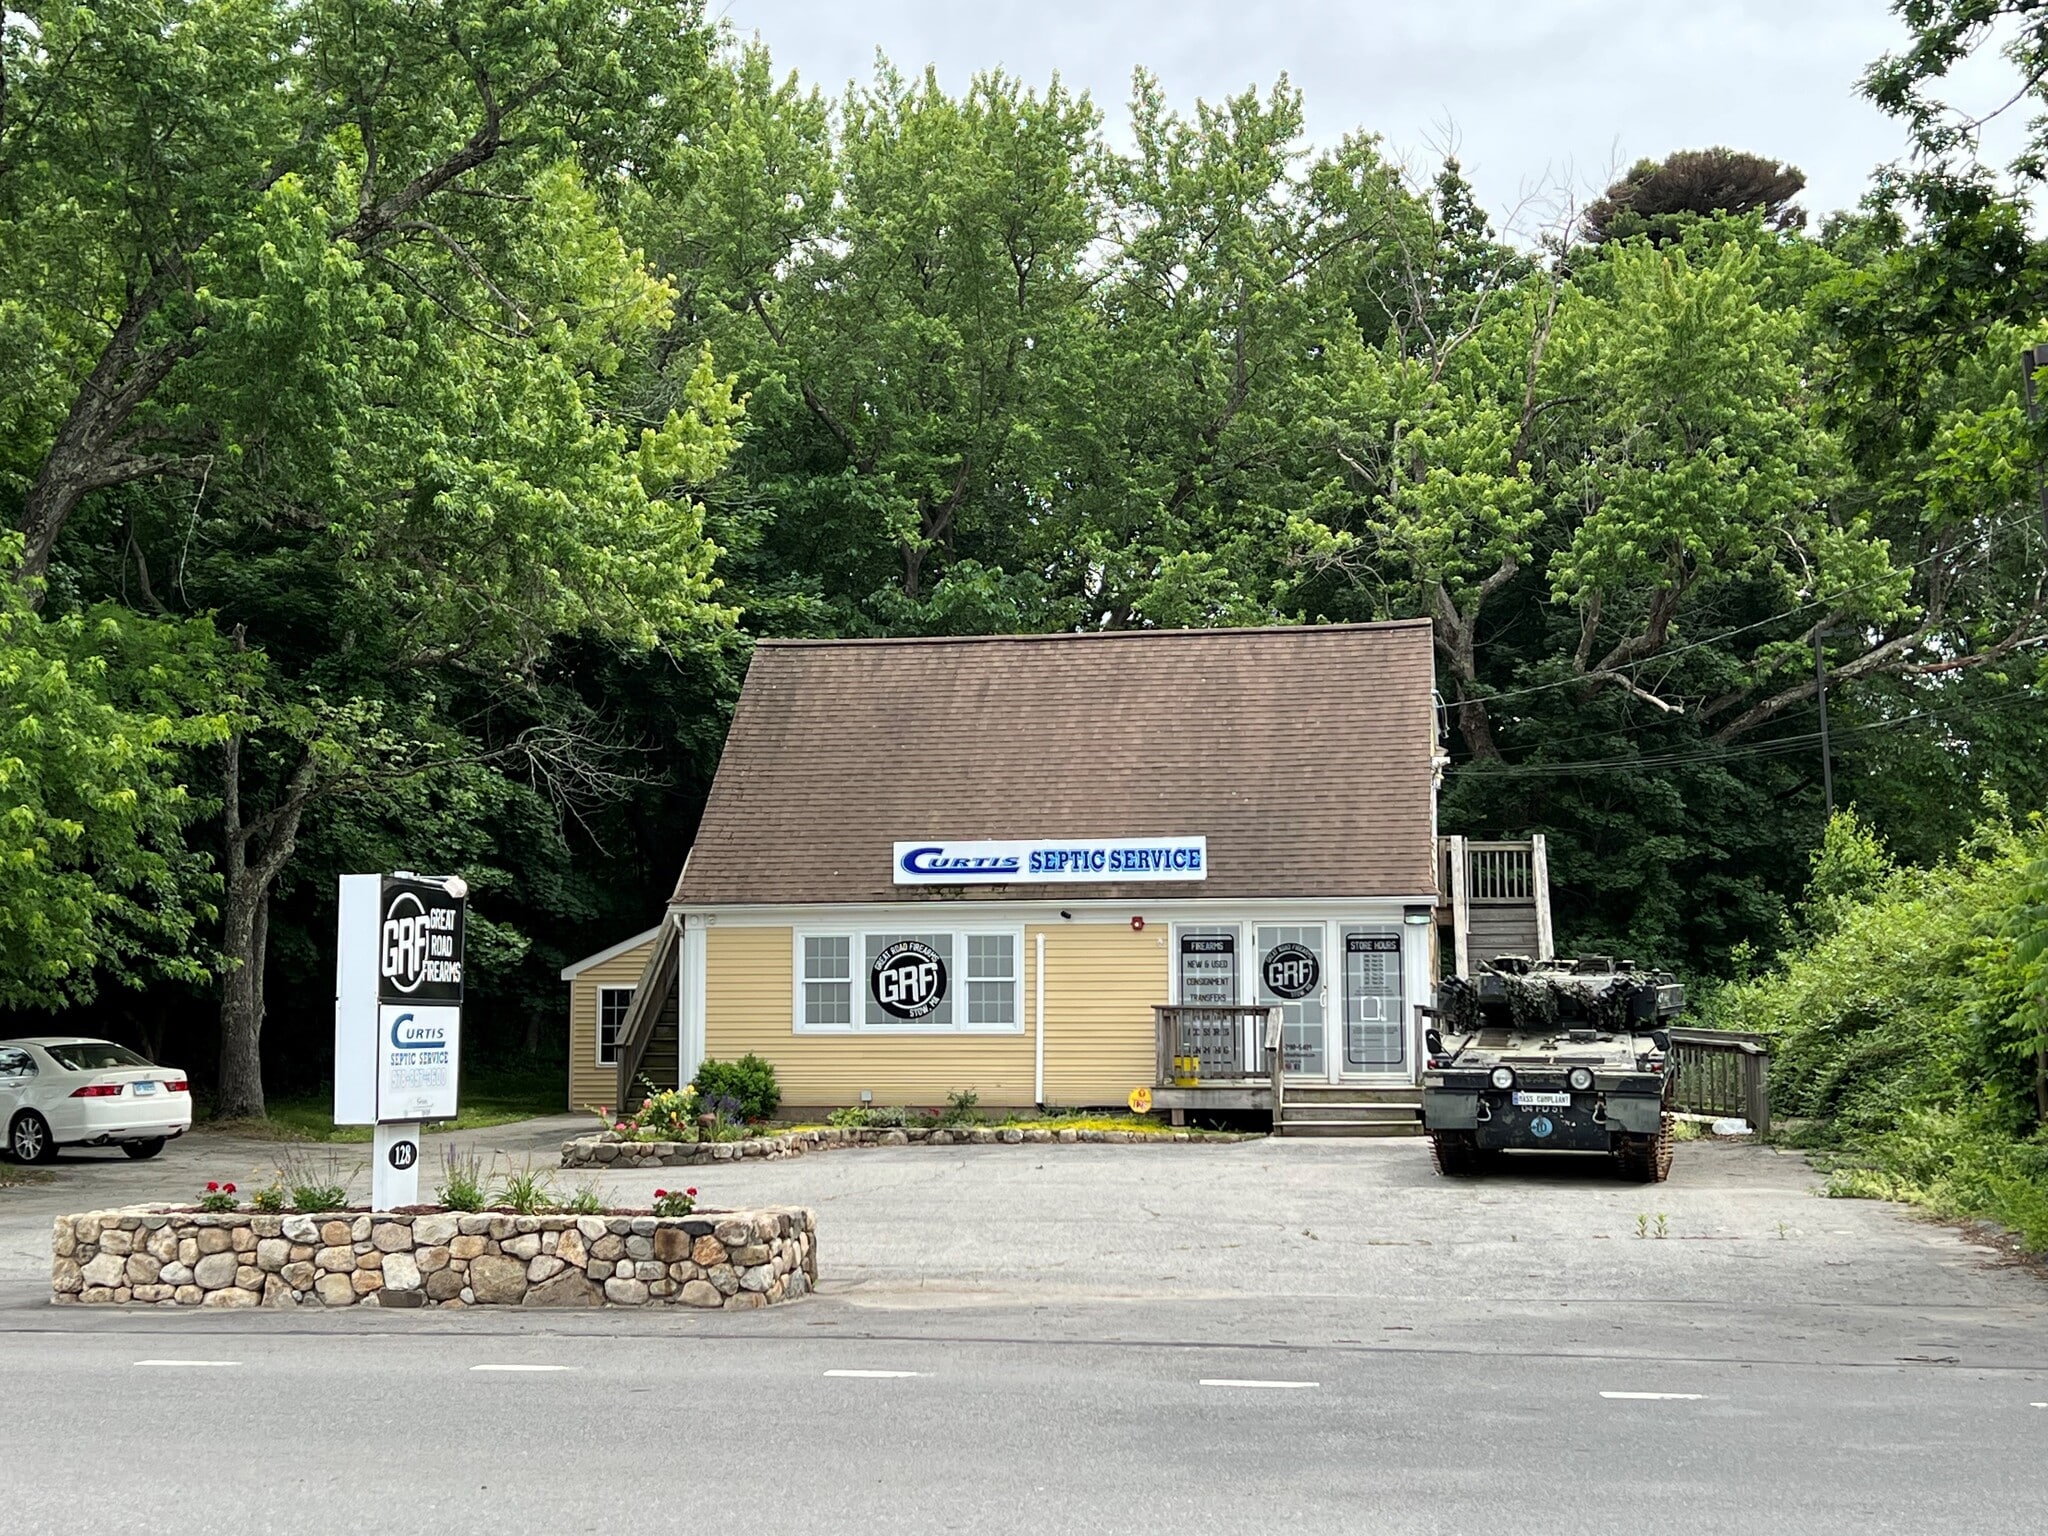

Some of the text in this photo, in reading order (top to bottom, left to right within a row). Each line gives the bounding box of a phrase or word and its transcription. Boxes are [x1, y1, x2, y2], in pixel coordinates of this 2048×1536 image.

[901, 847, 1201, 874] CURTIS SEPTIC SERVICE
[430, 908, 456, 930] GREAT
[382, 915, 430, 981] GRF
[431, 935, 453, 957] ROAD
[1191, 941, 1224, 951] FIREARMS
[1350, 940, 1397, 950] STORE HOURS
[874, 943, 940, 971] GREAT ROAD FIREARMS
[1187, 960, 1202, 968] NEW
[1211, 960, 1228, 968] USED
[422, 960, 461, 983] FIREARMS
[1269, 959, 1313, 987] GRF
[879, 963, 938, 1003] GRF
[391, 1013, 446, 1049] CURTIS
[390, 1050, 449, 1066] SEPTIC SERVICE
[394, 1144, 412, 1166] 128
